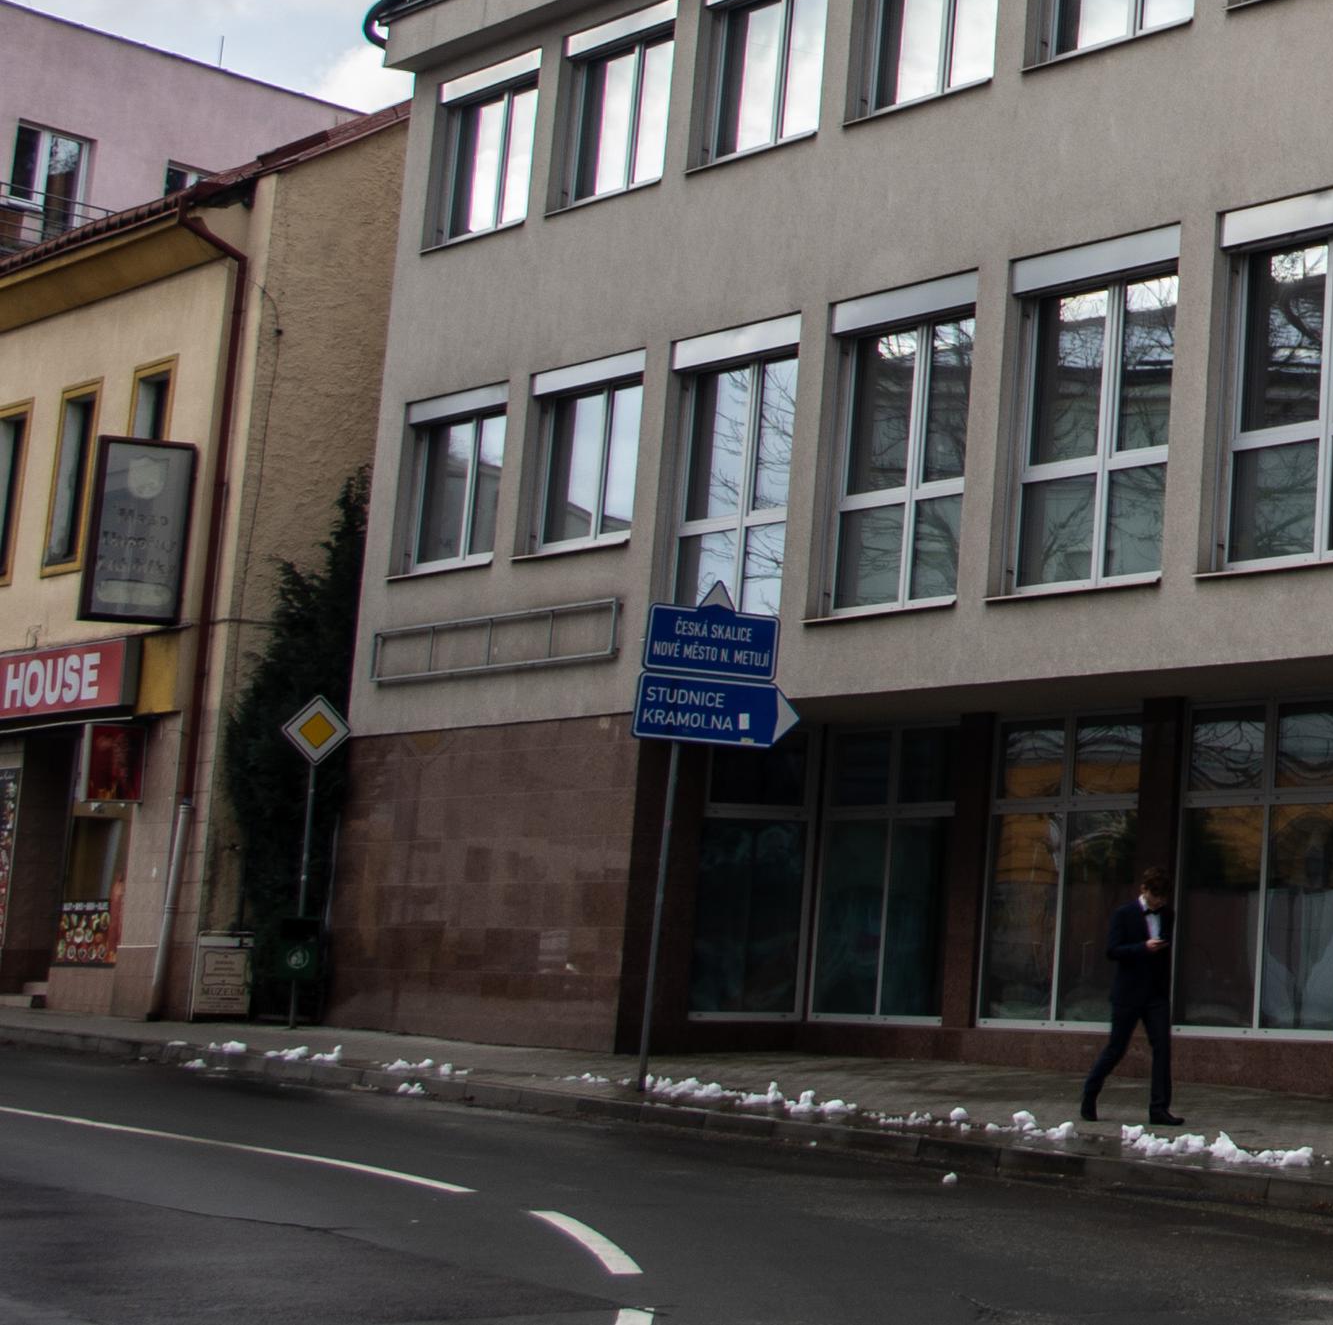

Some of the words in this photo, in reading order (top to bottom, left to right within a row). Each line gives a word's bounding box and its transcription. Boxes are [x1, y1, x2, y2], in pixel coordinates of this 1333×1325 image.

[675, 616, 708, 638] ČESKÁ
[710, 624, 753, 642] SKALICE
[653, 639, 681, 656] NOVÉ
[683, 641, 718, 662] MĚSTO
[720, 649, 730, 664] N.
[734, 649, 770, 668] METUJÍ
[3, 652, 101, 709] HOUSE
[646, 686, 726, 709] STUDNICE
[642, 708, 734, 732] KRAMOLNA
